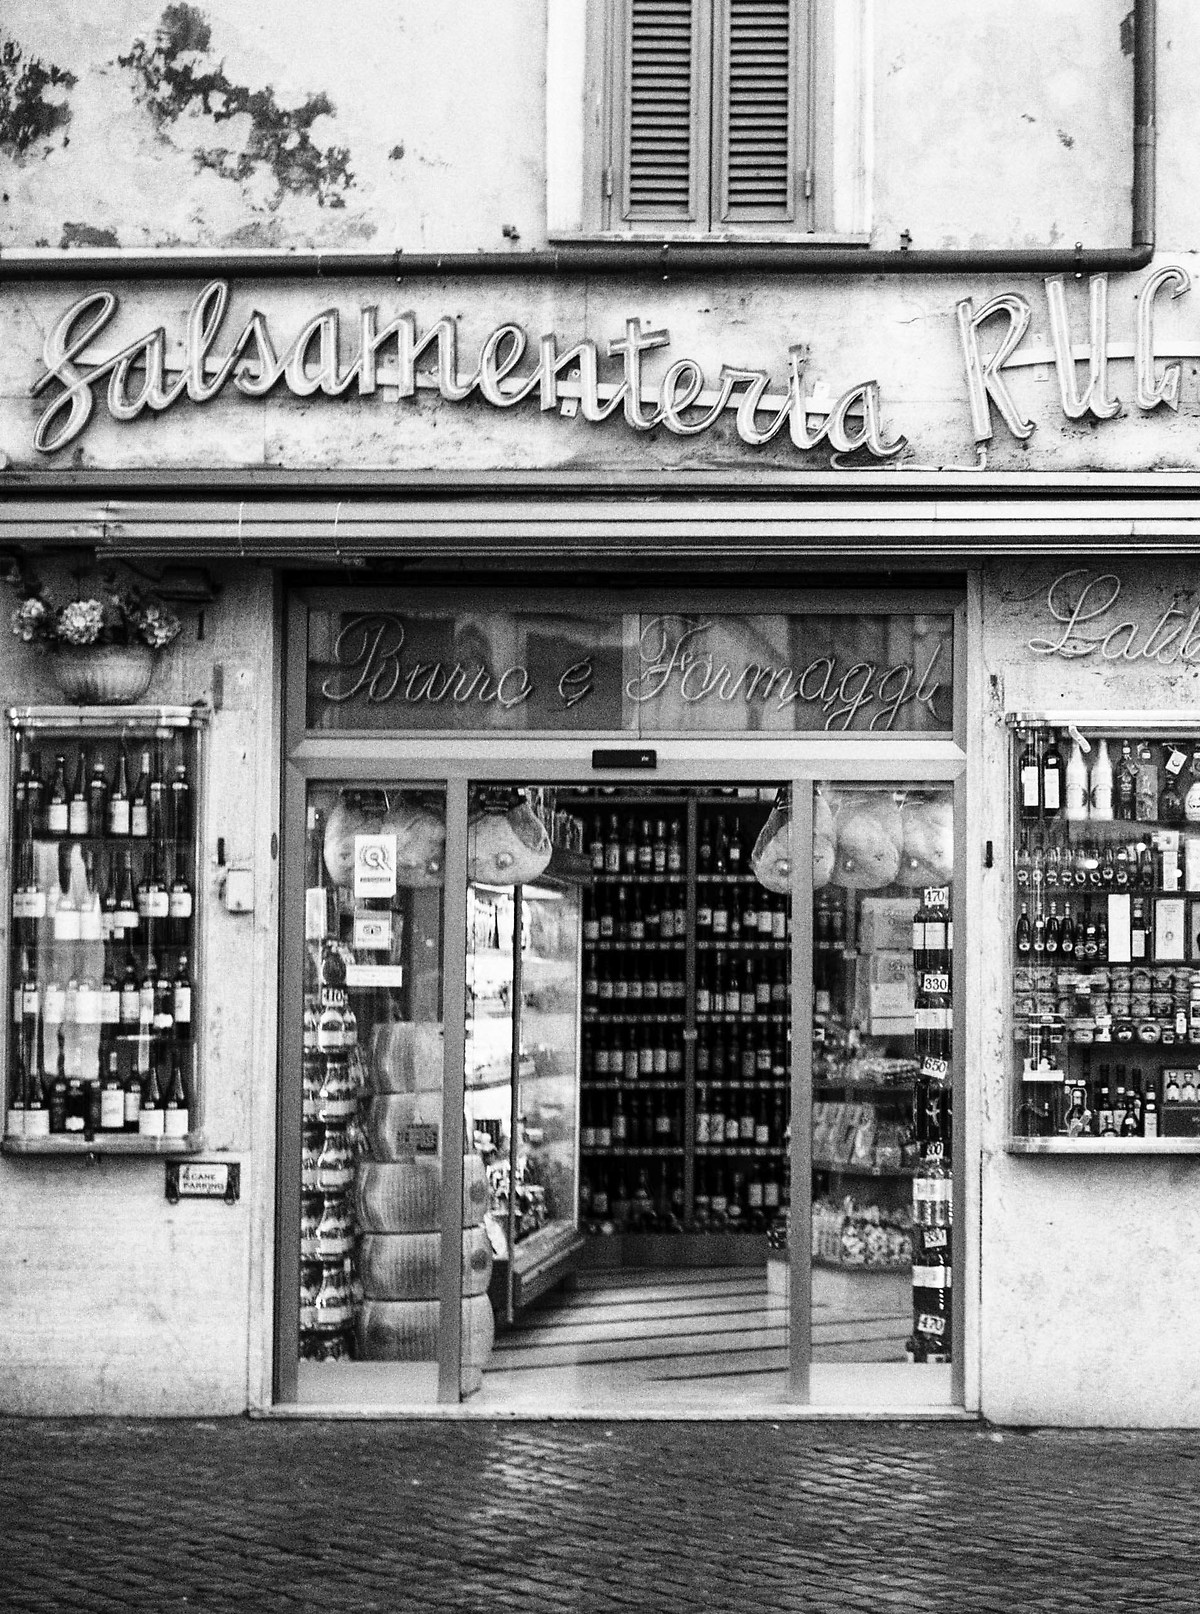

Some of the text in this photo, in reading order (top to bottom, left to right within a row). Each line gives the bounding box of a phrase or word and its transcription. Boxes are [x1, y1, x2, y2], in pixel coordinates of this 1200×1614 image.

[30, 281, 908, 457] Salsamenteria
[322, 613, 532, 708] Burro
[626, 614, 942, 731] Formaggi
[925, 978, 947, 990] 330
[924, 1058, 946, 1073] 650
